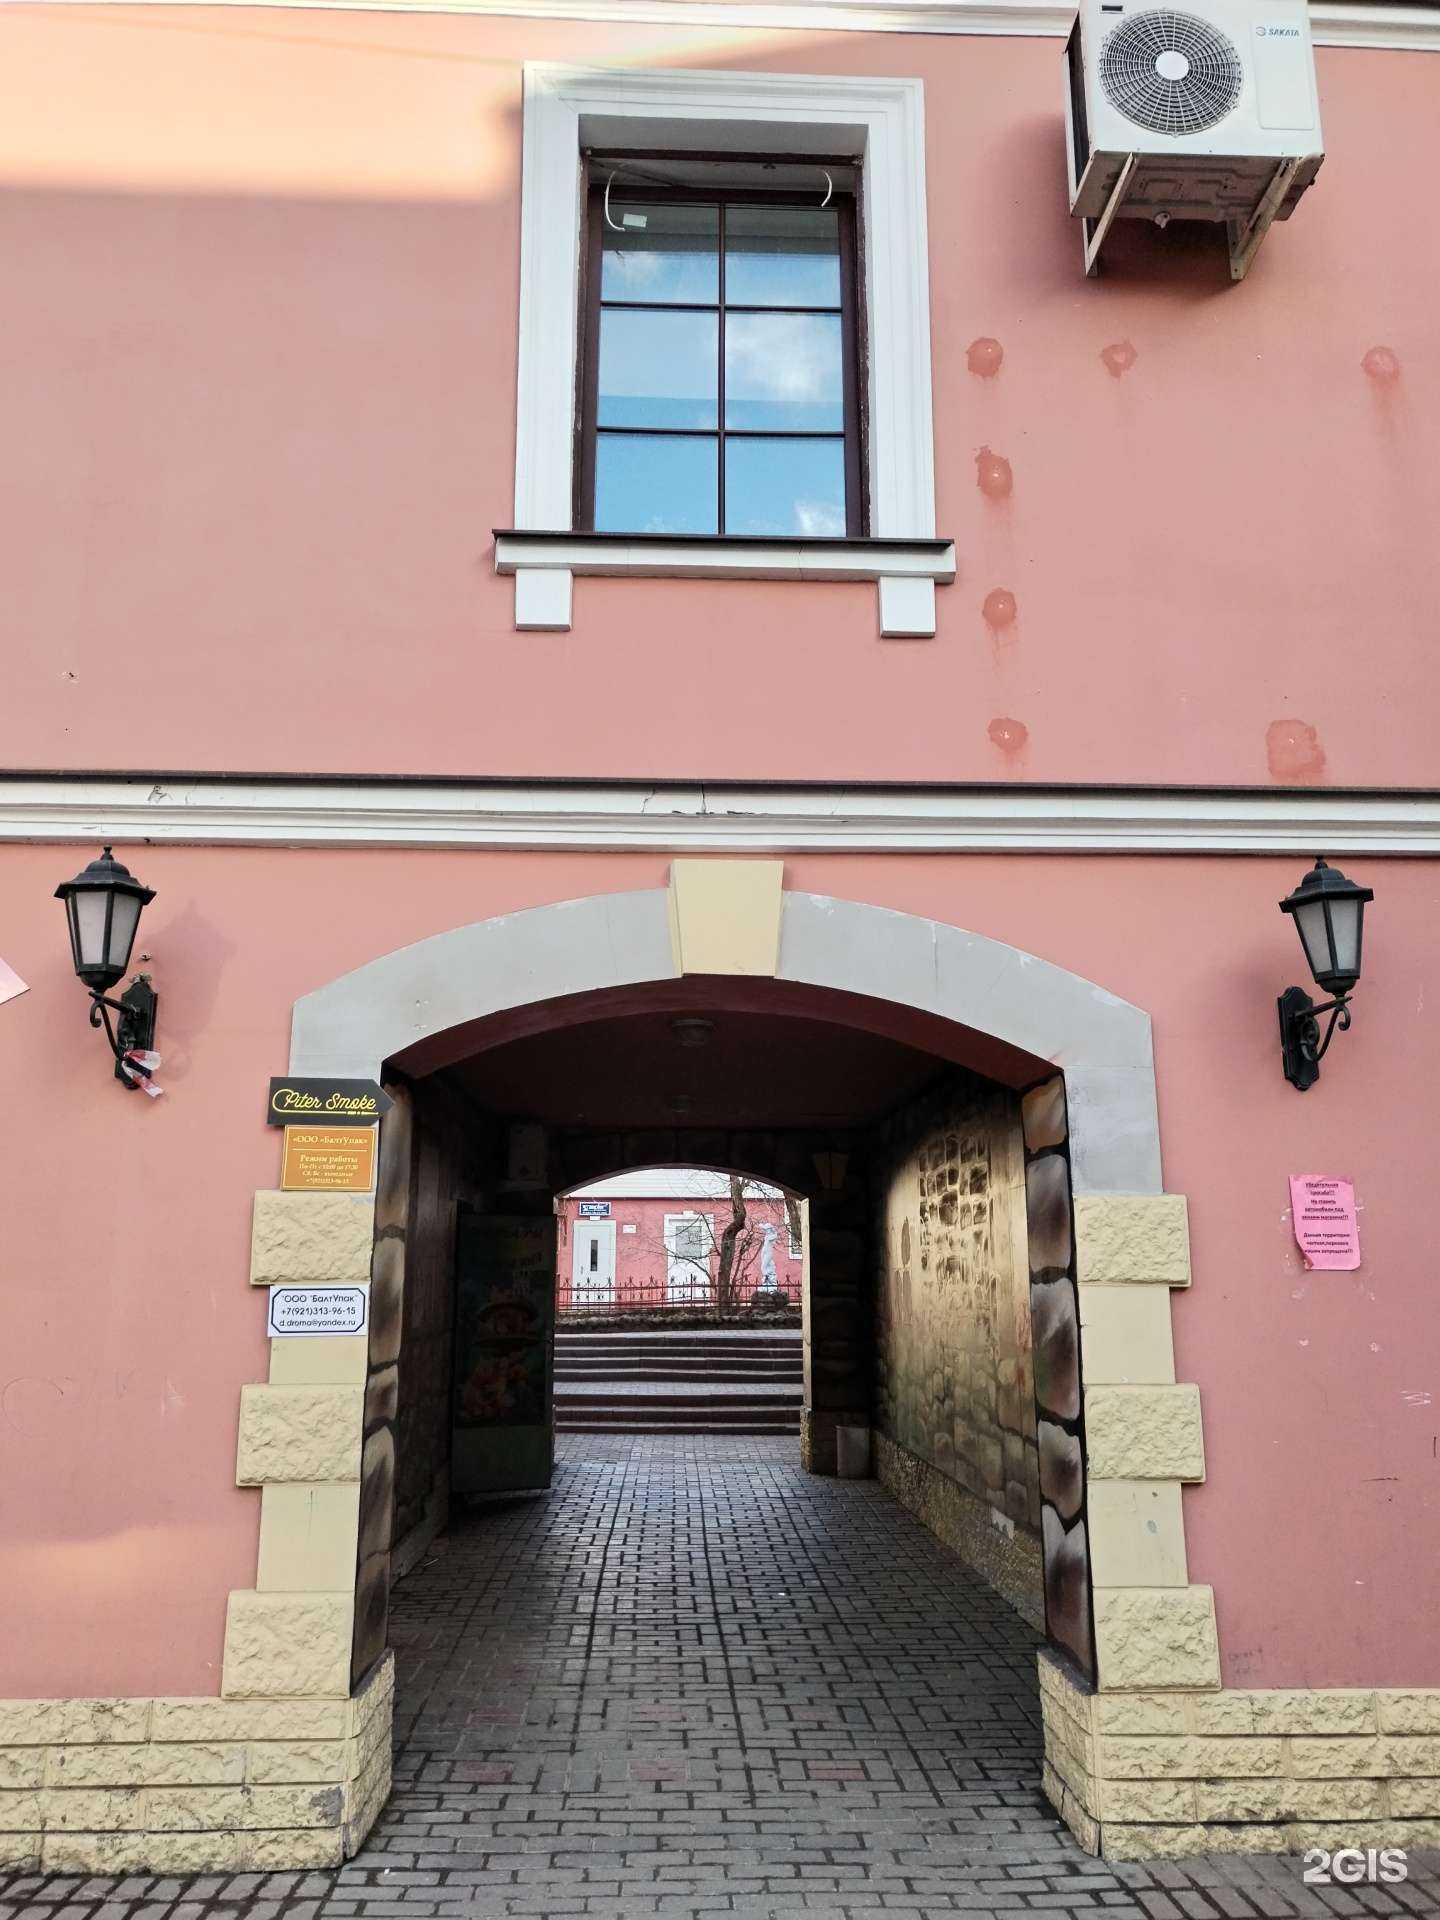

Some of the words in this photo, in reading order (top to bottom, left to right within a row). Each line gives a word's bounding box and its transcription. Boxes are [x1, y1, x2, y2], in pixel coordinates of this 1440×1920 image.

[1269, 28, 1300, 37] SAKATA
[274, 1089, 322, 1111] Piter
[325, 1092, 377, 1110] Smoke
[300, 1153, 328, 1163] Режим
[329, 1153, 358, 1164] работы
[281, 1306, 356, 1316] +7(921)313-96-15
[279, 1319, 356, 1328] d.droma@yandex.ru
